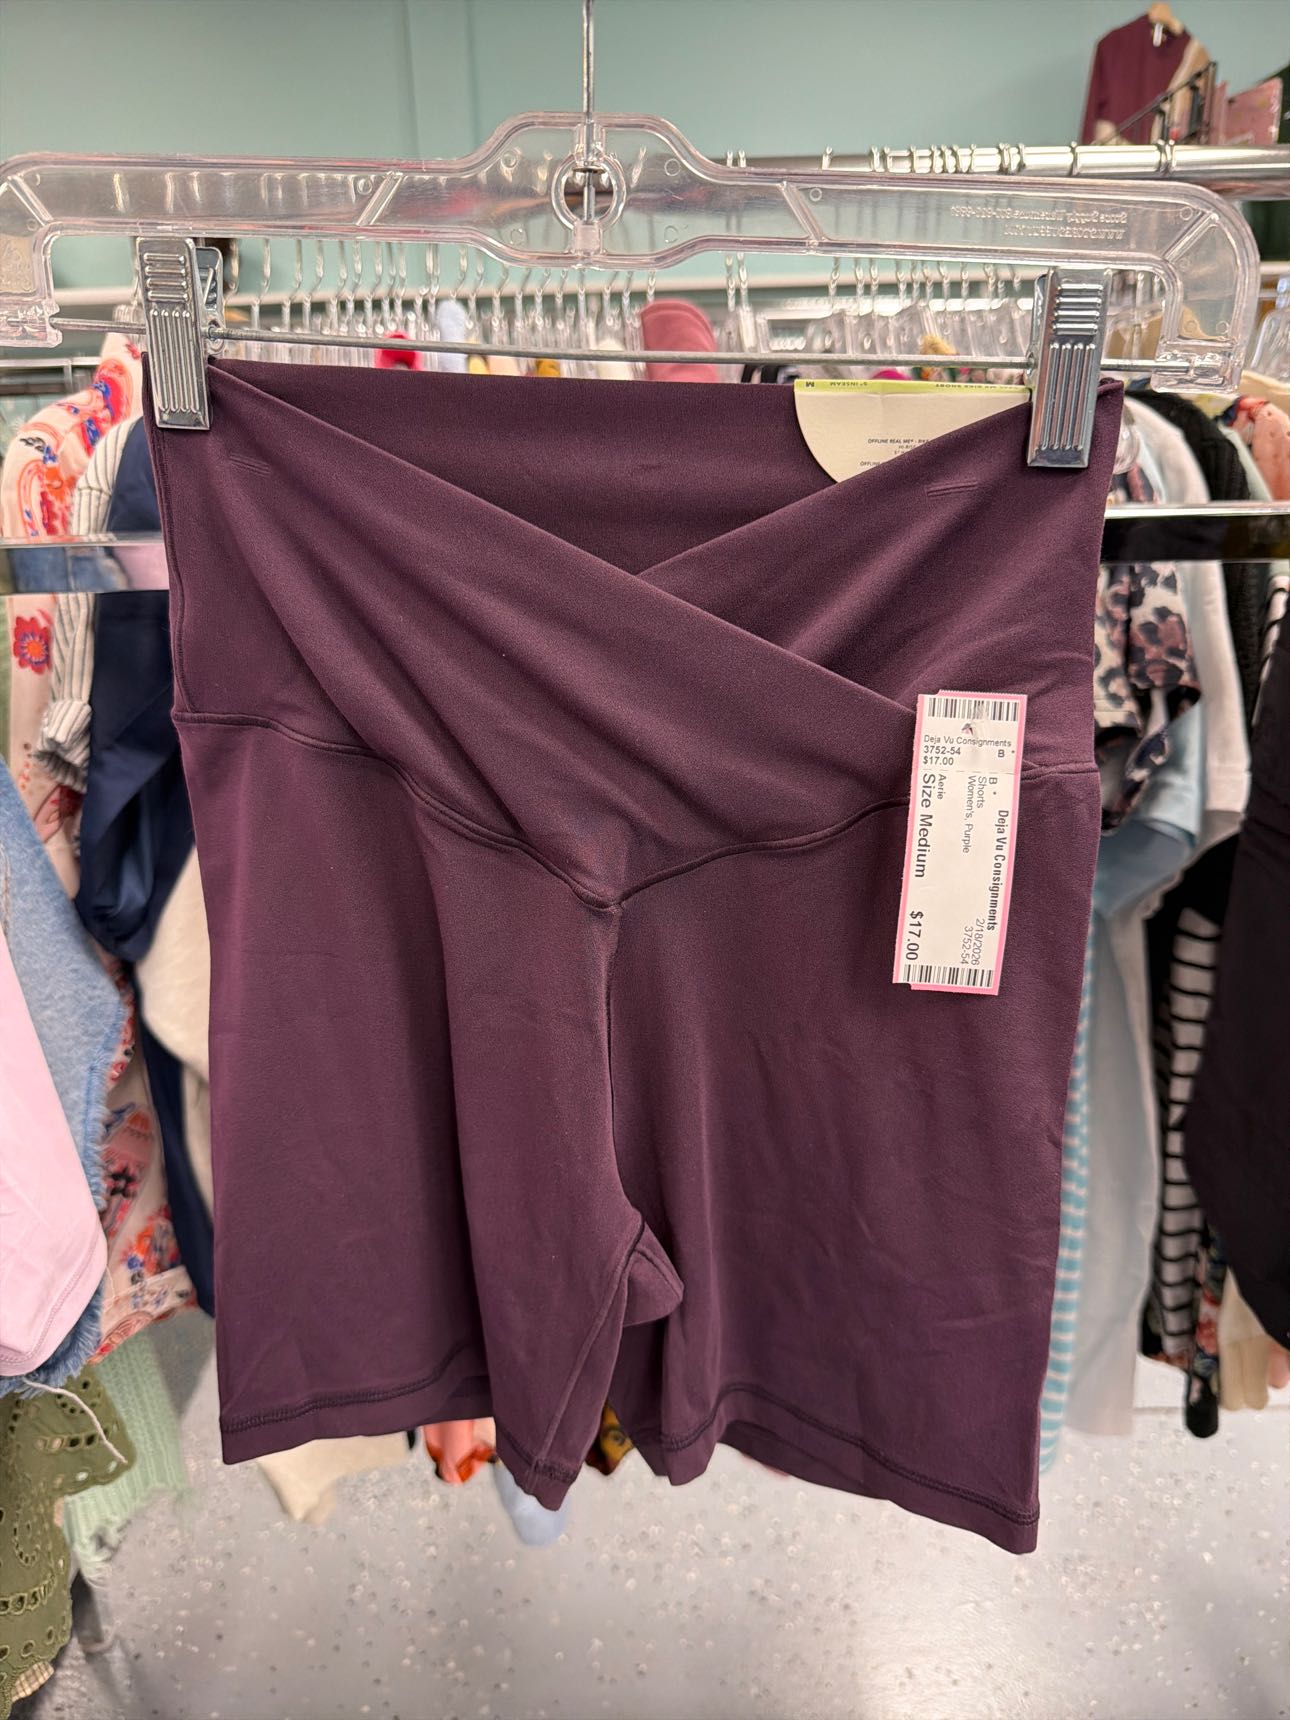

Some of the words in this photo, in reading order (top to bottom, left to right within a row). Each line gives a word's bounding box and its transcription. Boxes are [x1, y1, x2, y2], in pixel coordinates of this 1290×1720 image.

[924, 735, 941, 744] Deja
[944, 736, 954, 744] Vu
[956, 737, 1011, 747] Consignments
[924, 745, 961, 755] 3752-54
[998, 749, 1005, 758] B
[923, 756, 954, 765] $17.00
[921, 773, 936, 808] Size
[937, 773, 947, 800] Aerie
[976, 776, 987, 808] Shorts
[988, 777, 998, 785] B
[964, 775, 977, 820] Women's,
[995, 810, 1009, 834] Deja
[915, 814, 933, 877] Medium
[962, 823, 974, 853] Purple
[996, 837, 1007, 851] Vu
[987, 854, 1006, 931] Consignments
[906, 910, 924, 960] $17.00
[961, 926, 973, 965] 3752-54
[971, 918, 985, 966] 2/18/2026
